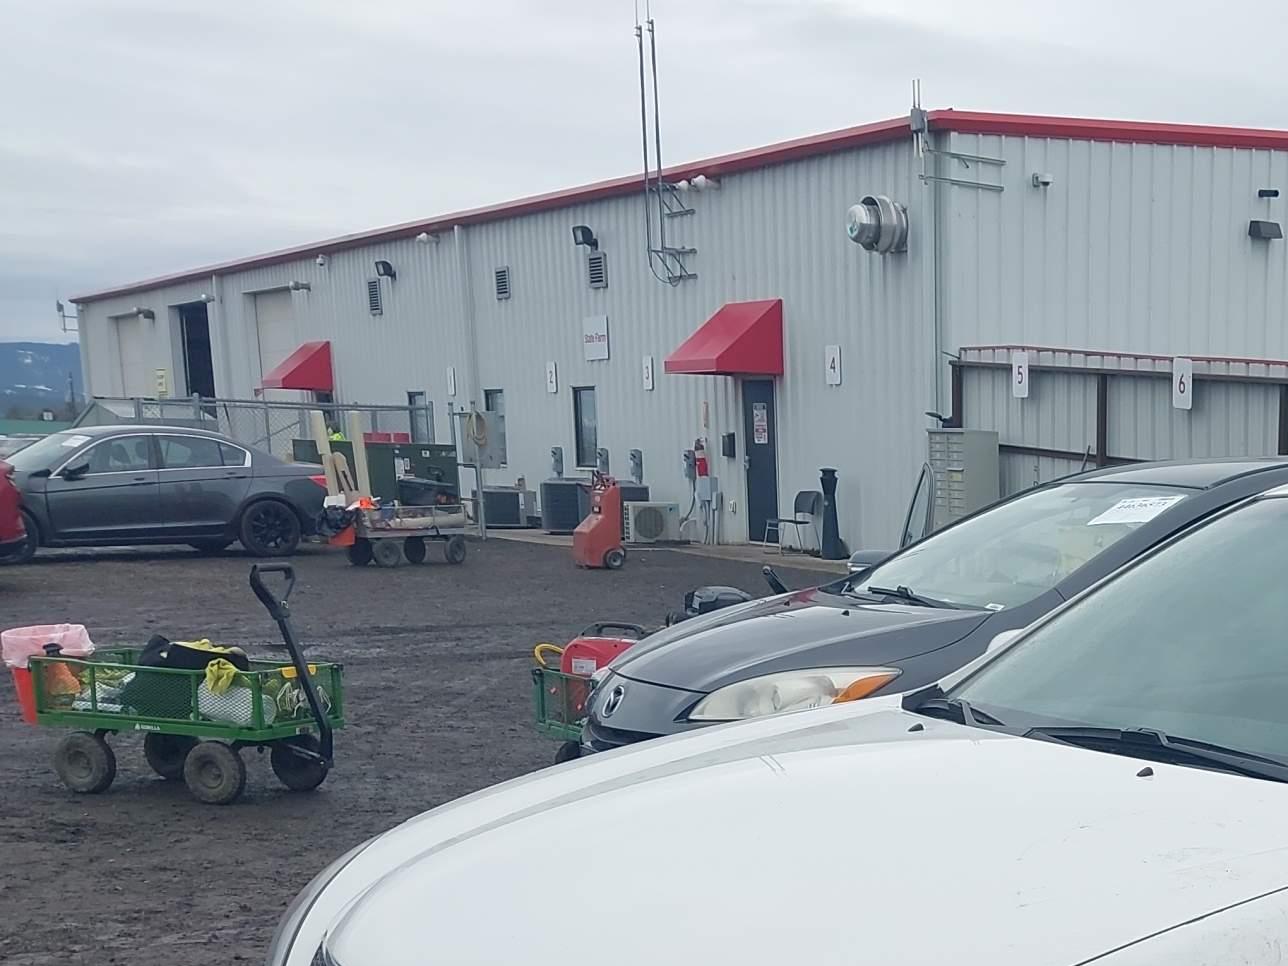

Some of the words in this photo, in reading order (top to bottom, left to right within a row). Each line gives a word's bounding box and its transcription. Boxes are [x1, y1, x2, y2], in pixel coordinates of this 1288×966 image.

[829, 356, 836, 373] 4
[549, 370, 554, 384] 2
[1017, 365, 1024, 384] 5
[1178, 374, 1186, 394] 6
